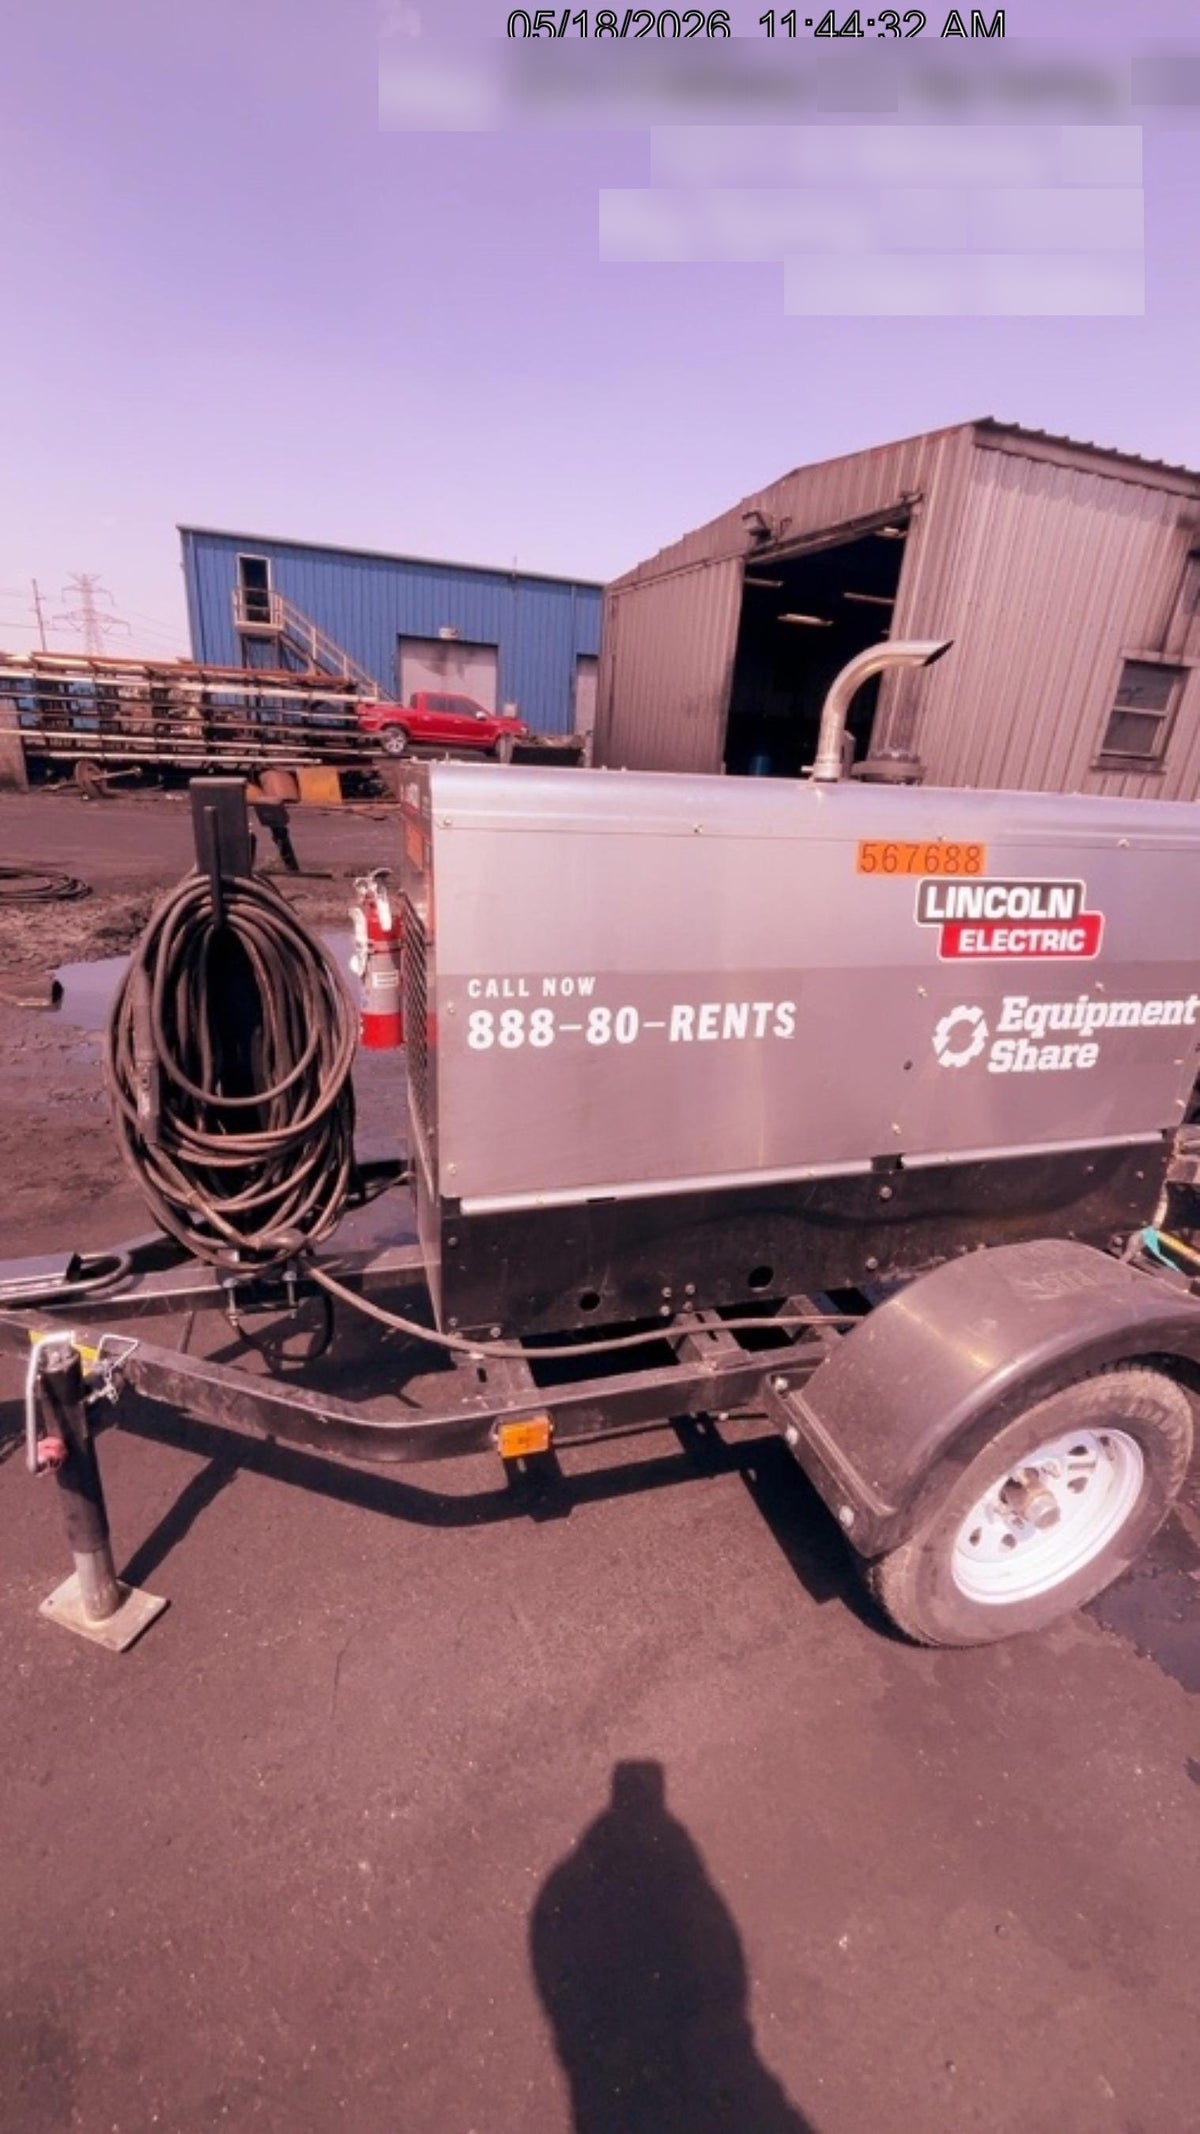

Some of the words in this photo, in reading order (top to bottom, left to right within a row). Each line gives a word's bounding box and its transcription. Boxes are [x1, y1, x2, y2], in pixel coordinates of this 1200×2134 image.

[859, 843, 981, 874] 567688
[925, 885, 1076, 919] LINCOLN
[957, 928, 1087, 953] ELECTRIC
[467, 978, 530, 998] CALL
[542, 976, 596, 997] NOW
[466, 1001, 797, 1050] 888-80-RENTS
[996, 994, 1200, 1039] Equipment
[987, 1038, 1099, 1073] Share
